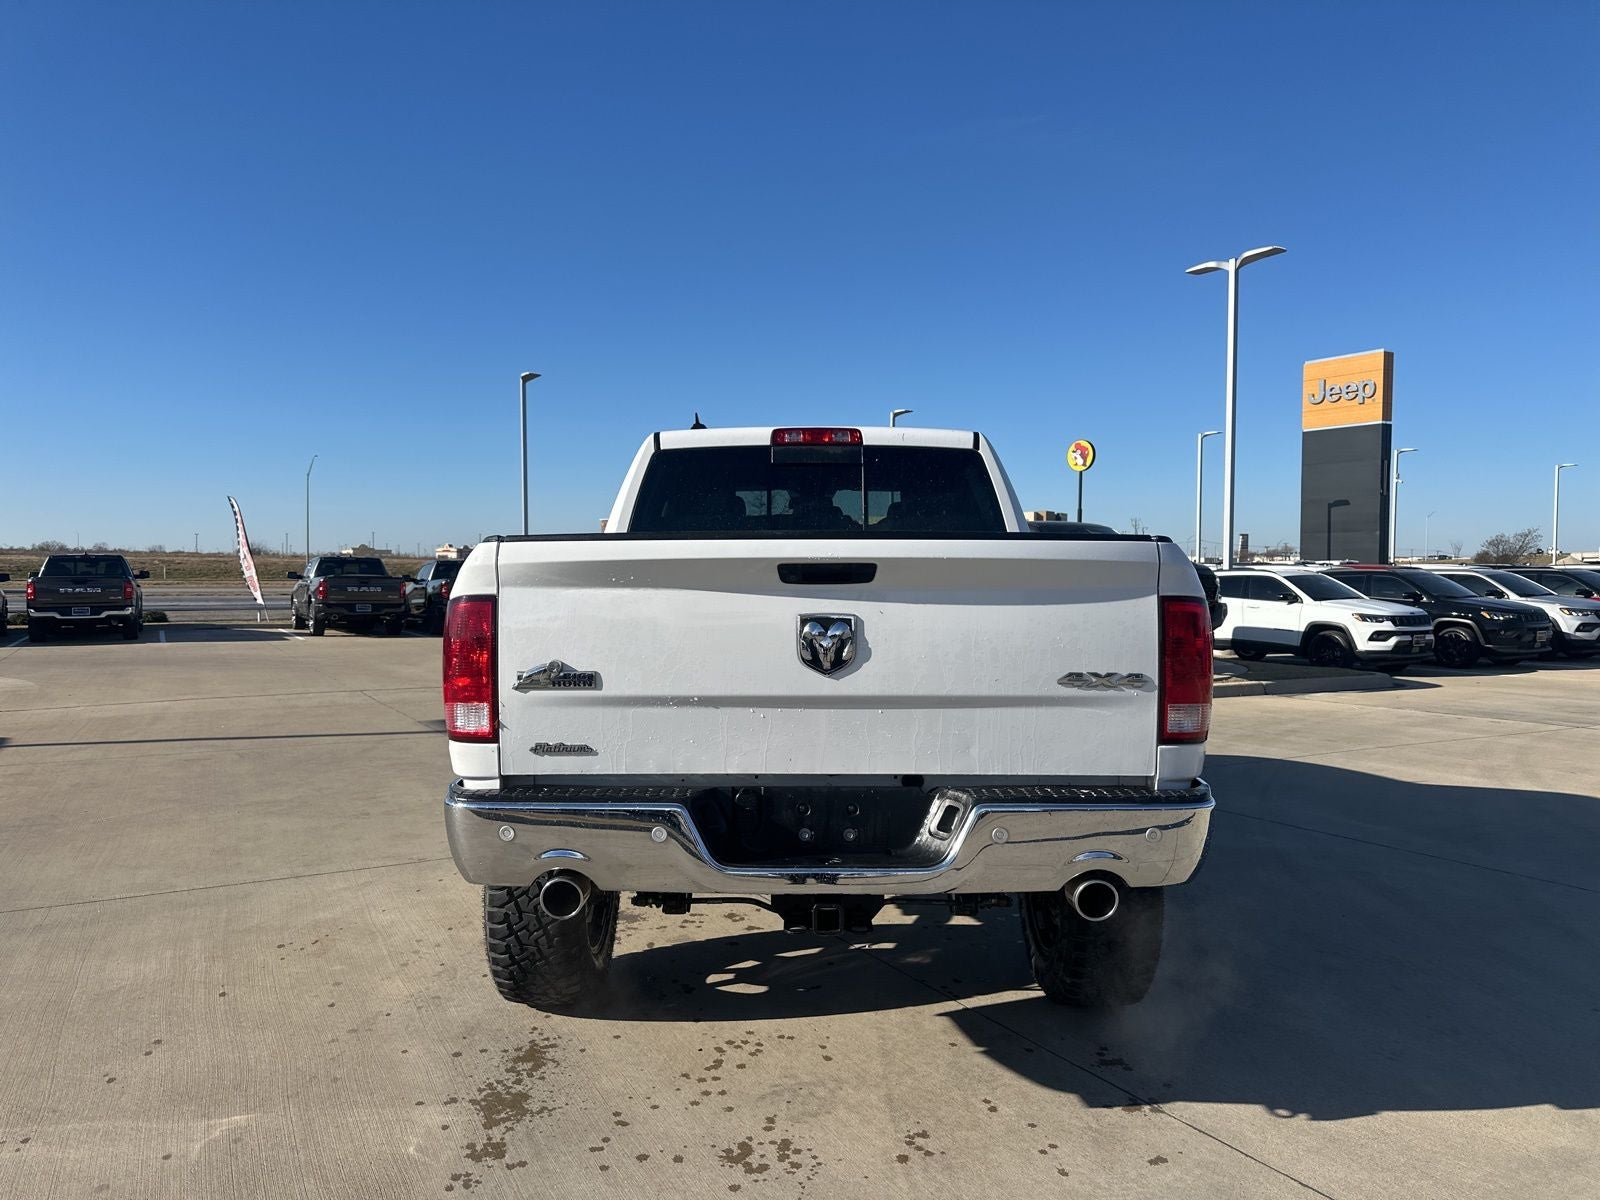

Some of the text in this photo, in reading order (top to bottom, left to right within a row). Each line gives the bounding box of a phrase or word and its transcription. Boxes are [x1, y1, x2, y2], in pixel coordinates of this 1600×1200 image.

[1308, 378, 1377, 405] Jeep
[551, 680, 593, 688] HORN
[533, 742, 592, 754] Platinum
